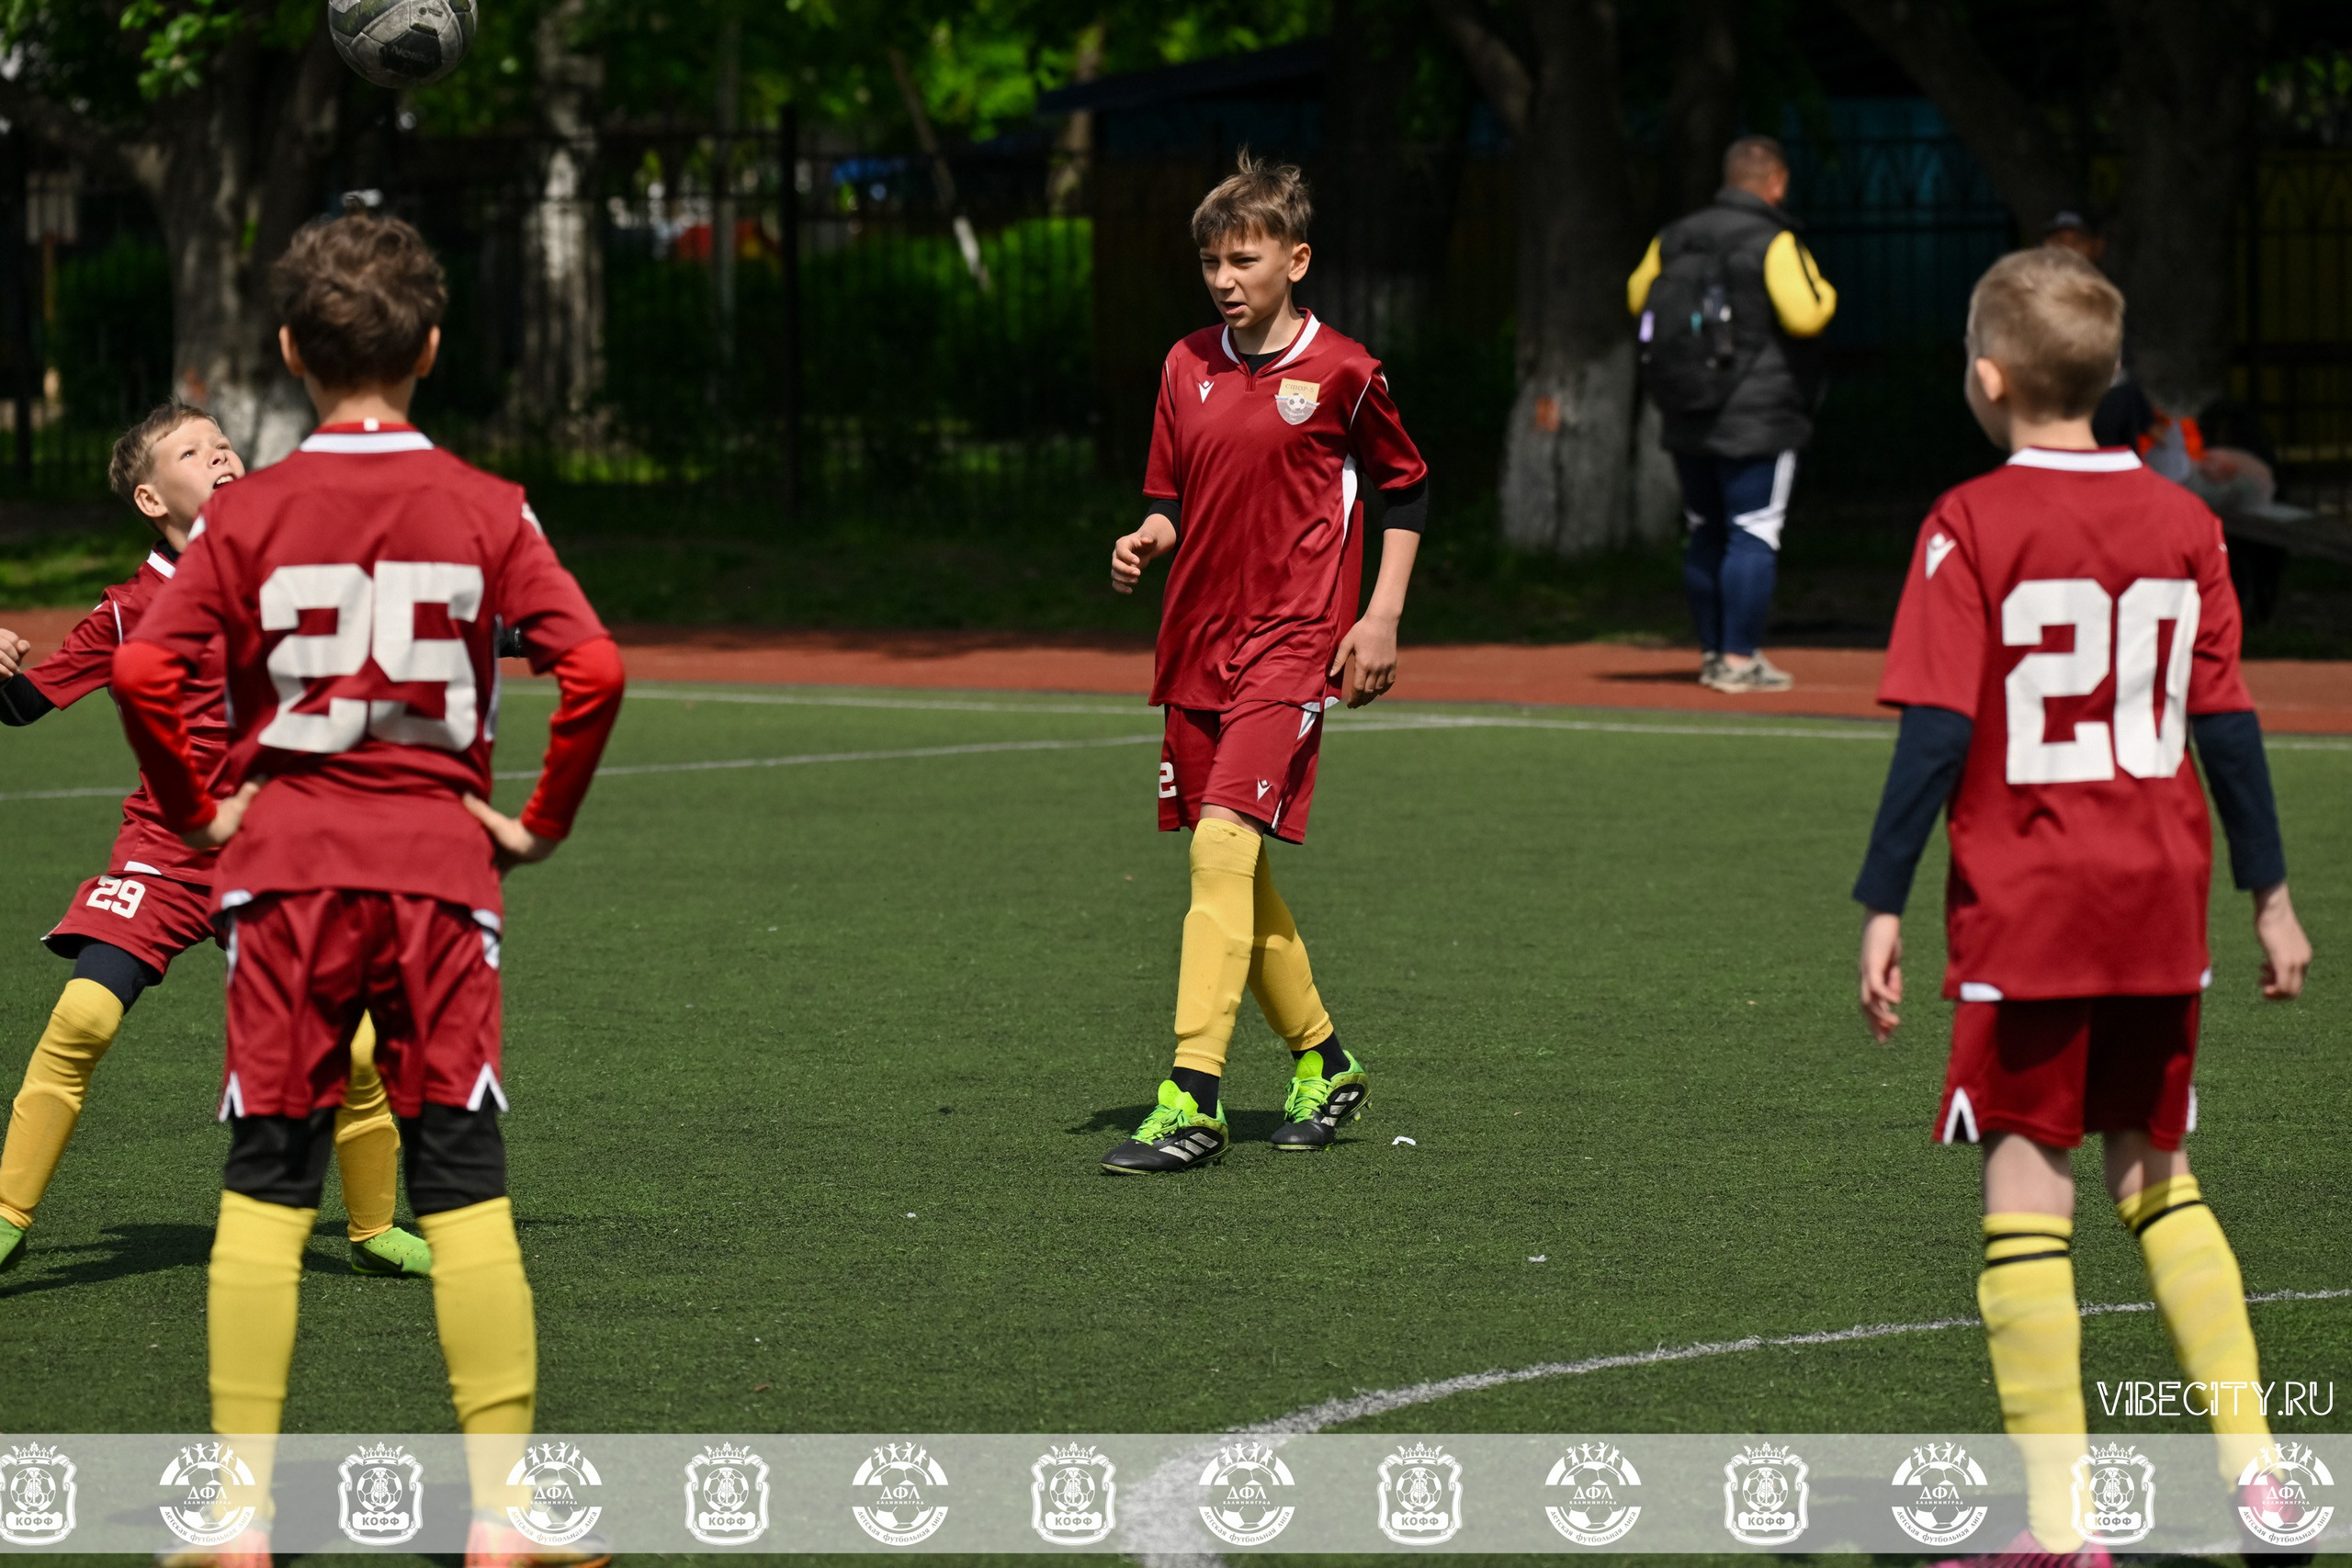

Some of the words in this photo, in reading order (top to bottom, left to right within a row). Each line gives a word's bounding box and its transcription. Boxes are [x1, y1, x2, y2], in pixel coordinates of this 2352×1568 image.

[258, 560, 483, 752] 25
[2002, 578, 2201, 784] 20
[85, 874, 146, 919] 29
